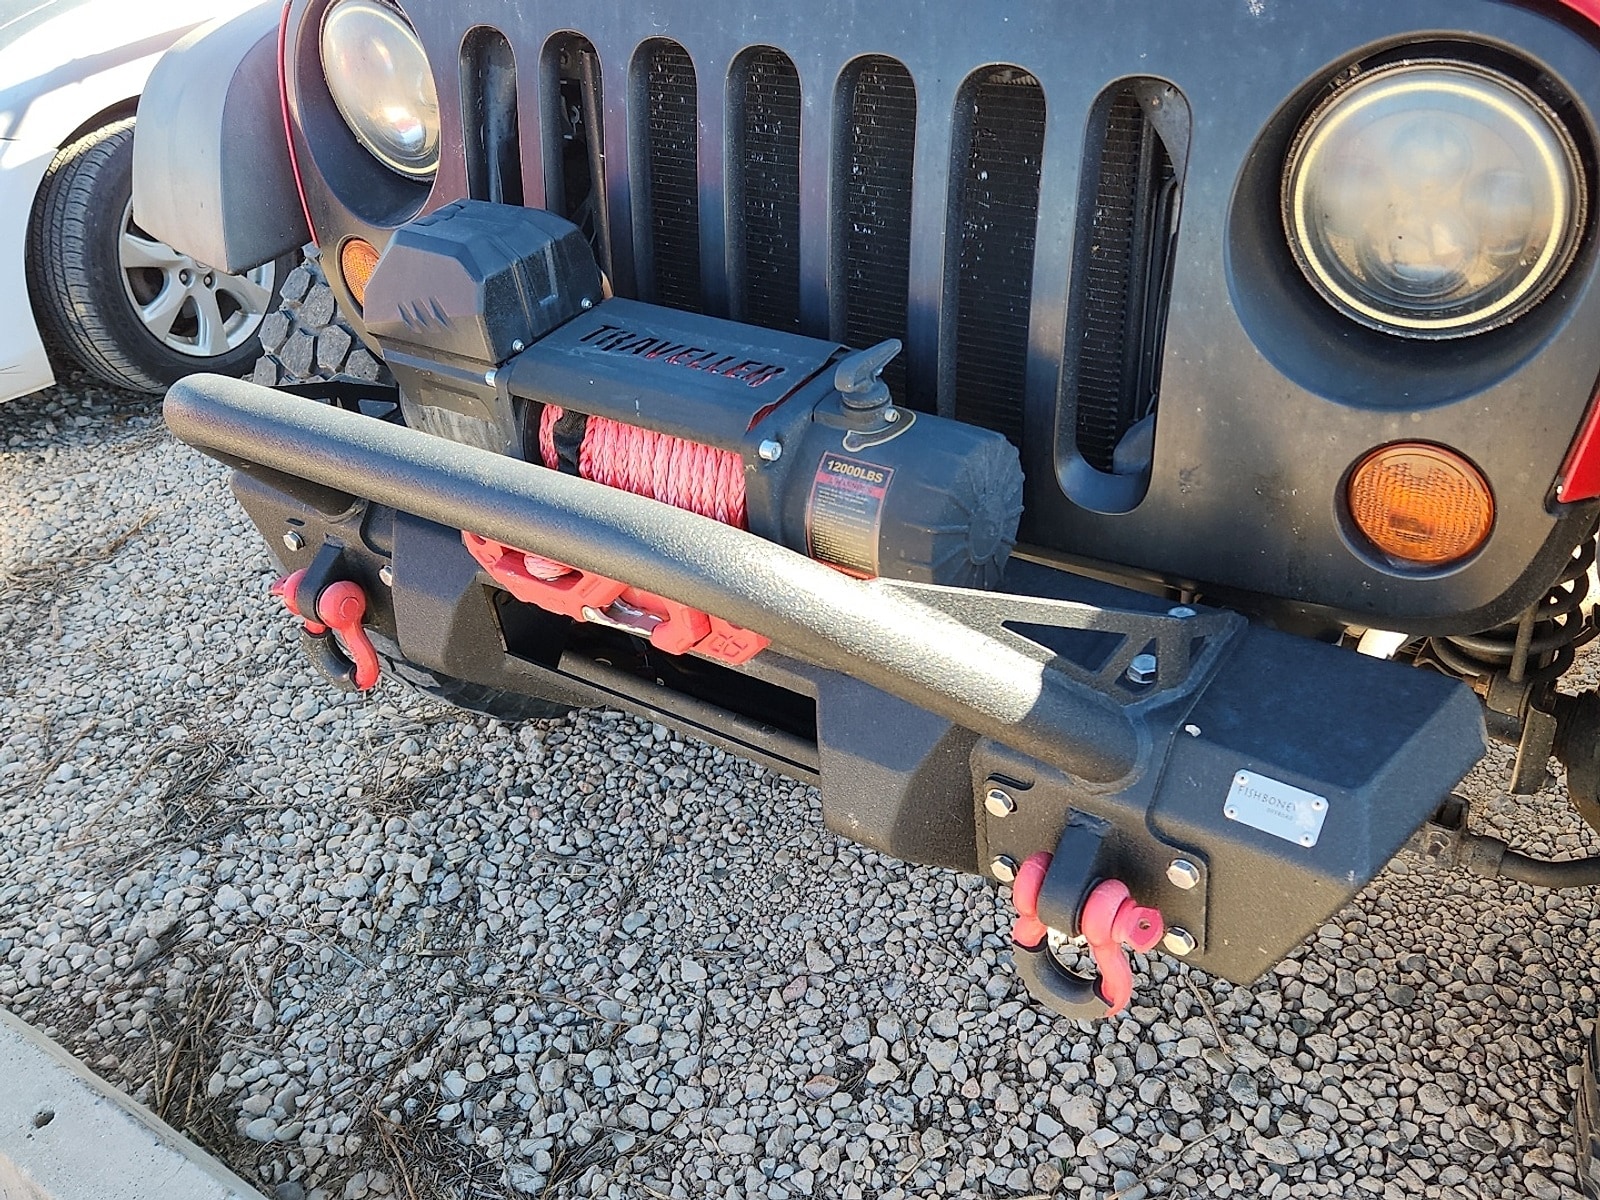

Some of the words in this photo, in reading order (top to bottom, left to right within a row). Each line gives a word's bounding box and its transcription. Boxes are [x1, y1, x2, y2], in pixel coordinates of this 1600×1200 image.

[579, 324, 787, 388] TRAVELLER
[827, 460, 884, 484] 12000LBS
[1238, 785, 1293, 812] FISHBONE
